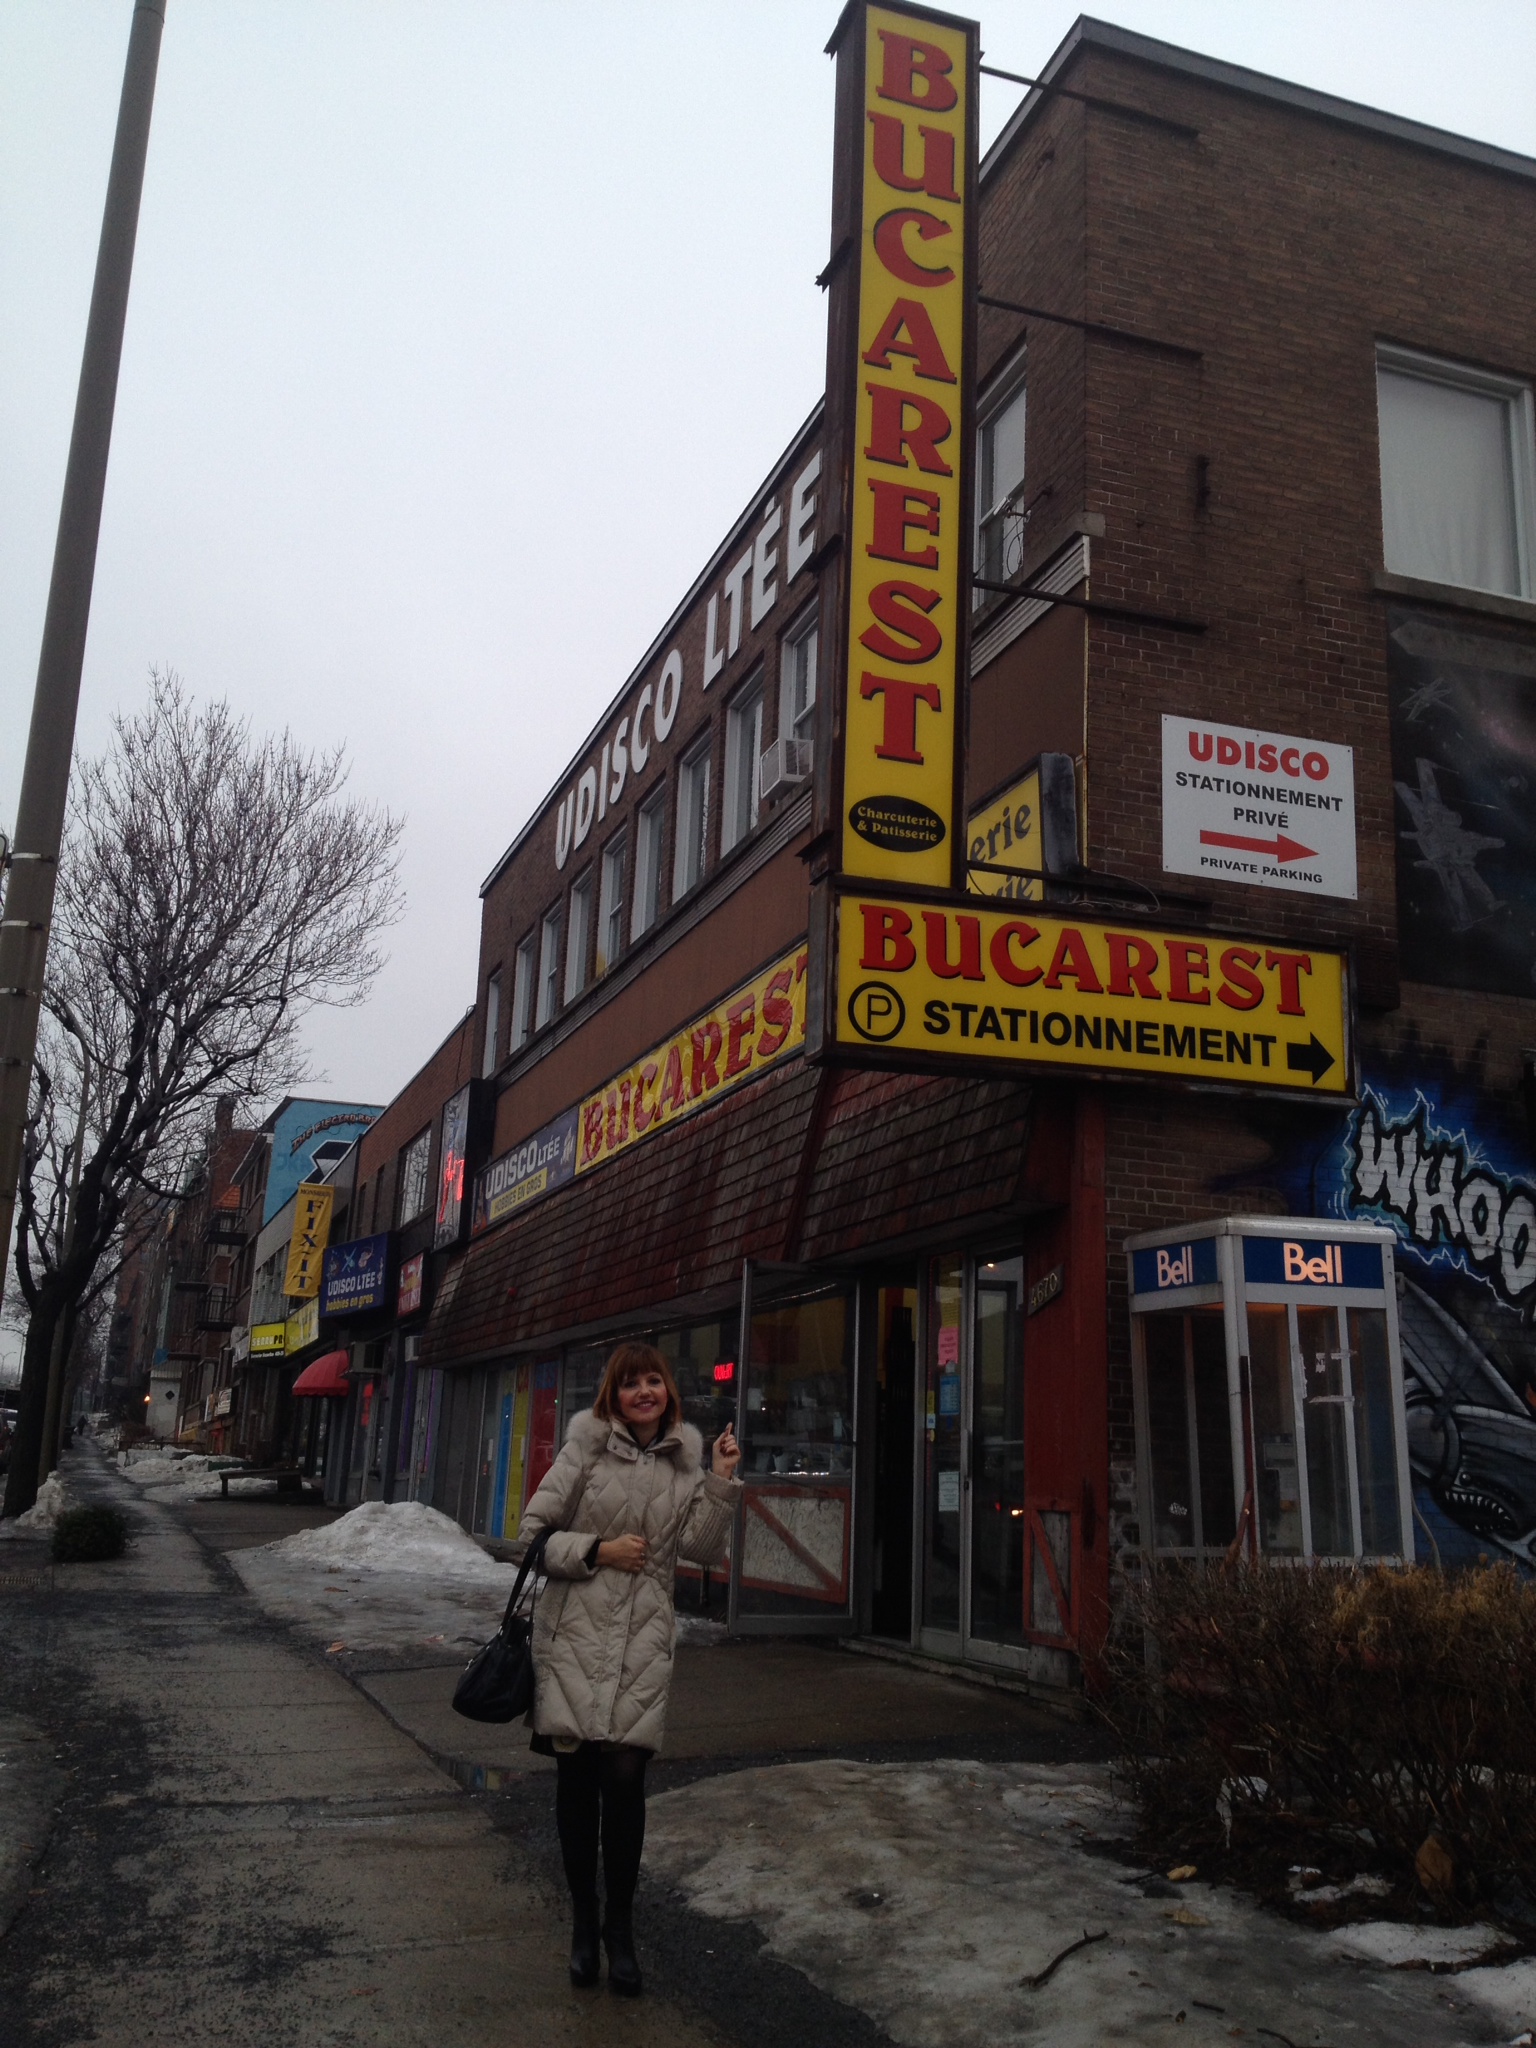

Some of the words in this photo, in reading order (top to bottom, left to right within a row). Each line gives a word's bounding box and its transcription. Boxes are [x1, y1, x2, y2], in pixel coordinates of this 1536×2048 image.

[858, 28, 960, 763] BUCAREST
[555, 648, 682, 871] UDISCO
[703, 449, 821, 691] LTÉE
[1188, 731, 1330, 781] UDISCO
[1175, 771, 1343, 812] STATIONNEMENT
[857, 805, 937, 828] Charcuterie
[857, 819, 868, 832] &
[872, 822, 938, 842] Patisserie
[1233, 807, 1289, 829] PRIVÉ
[1200, 856, 1258, 874] PRIVATE
[1262, 866, 1323, 884] PARKING
[858, 903, 1312, 1017] BUCAREST
[923, 999, 1277, 1067] STATIONNEMENT
[485, 1140, 538, 1199] UDISCO
[537, 1135, 560, 1167] LTÉE
[517, 1183, 526, 1201] EN
[327, 1276, 356, 1297] UDISCO
[357, 1268, 376, 1291] LTÉE
[1156, 1246, 1194, 1288] Bell
[1283, 1243, 1344, 1284] Bell
[1031, 1272, 1058, 1307] 4670
